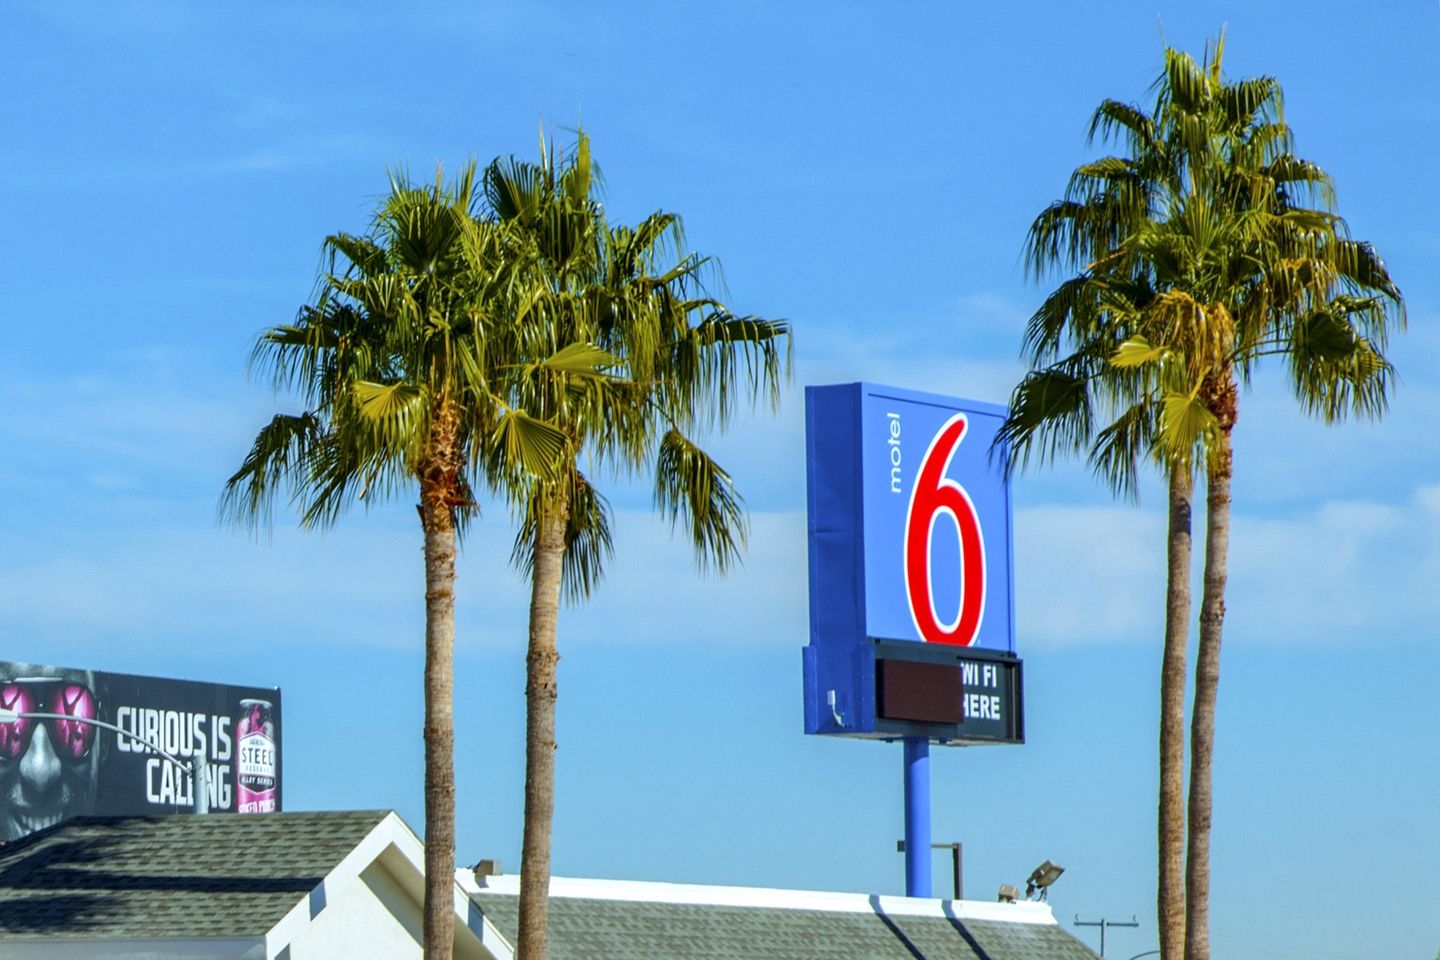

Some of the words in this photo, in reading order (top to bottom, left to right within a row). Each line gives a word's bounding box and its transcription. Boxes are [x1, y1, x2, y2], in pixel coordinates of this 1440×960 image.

[887, 412, 901, 493] motel
[903, 411, 987, 647] 6
[983, 664, 997, 688] FI
[117, 706, 207, 757] CURIOUS
[211, 715, 231, 760] IS
[242, 747, 273, 767] STEEL
[146, 758, 231, 809] CALLNG
